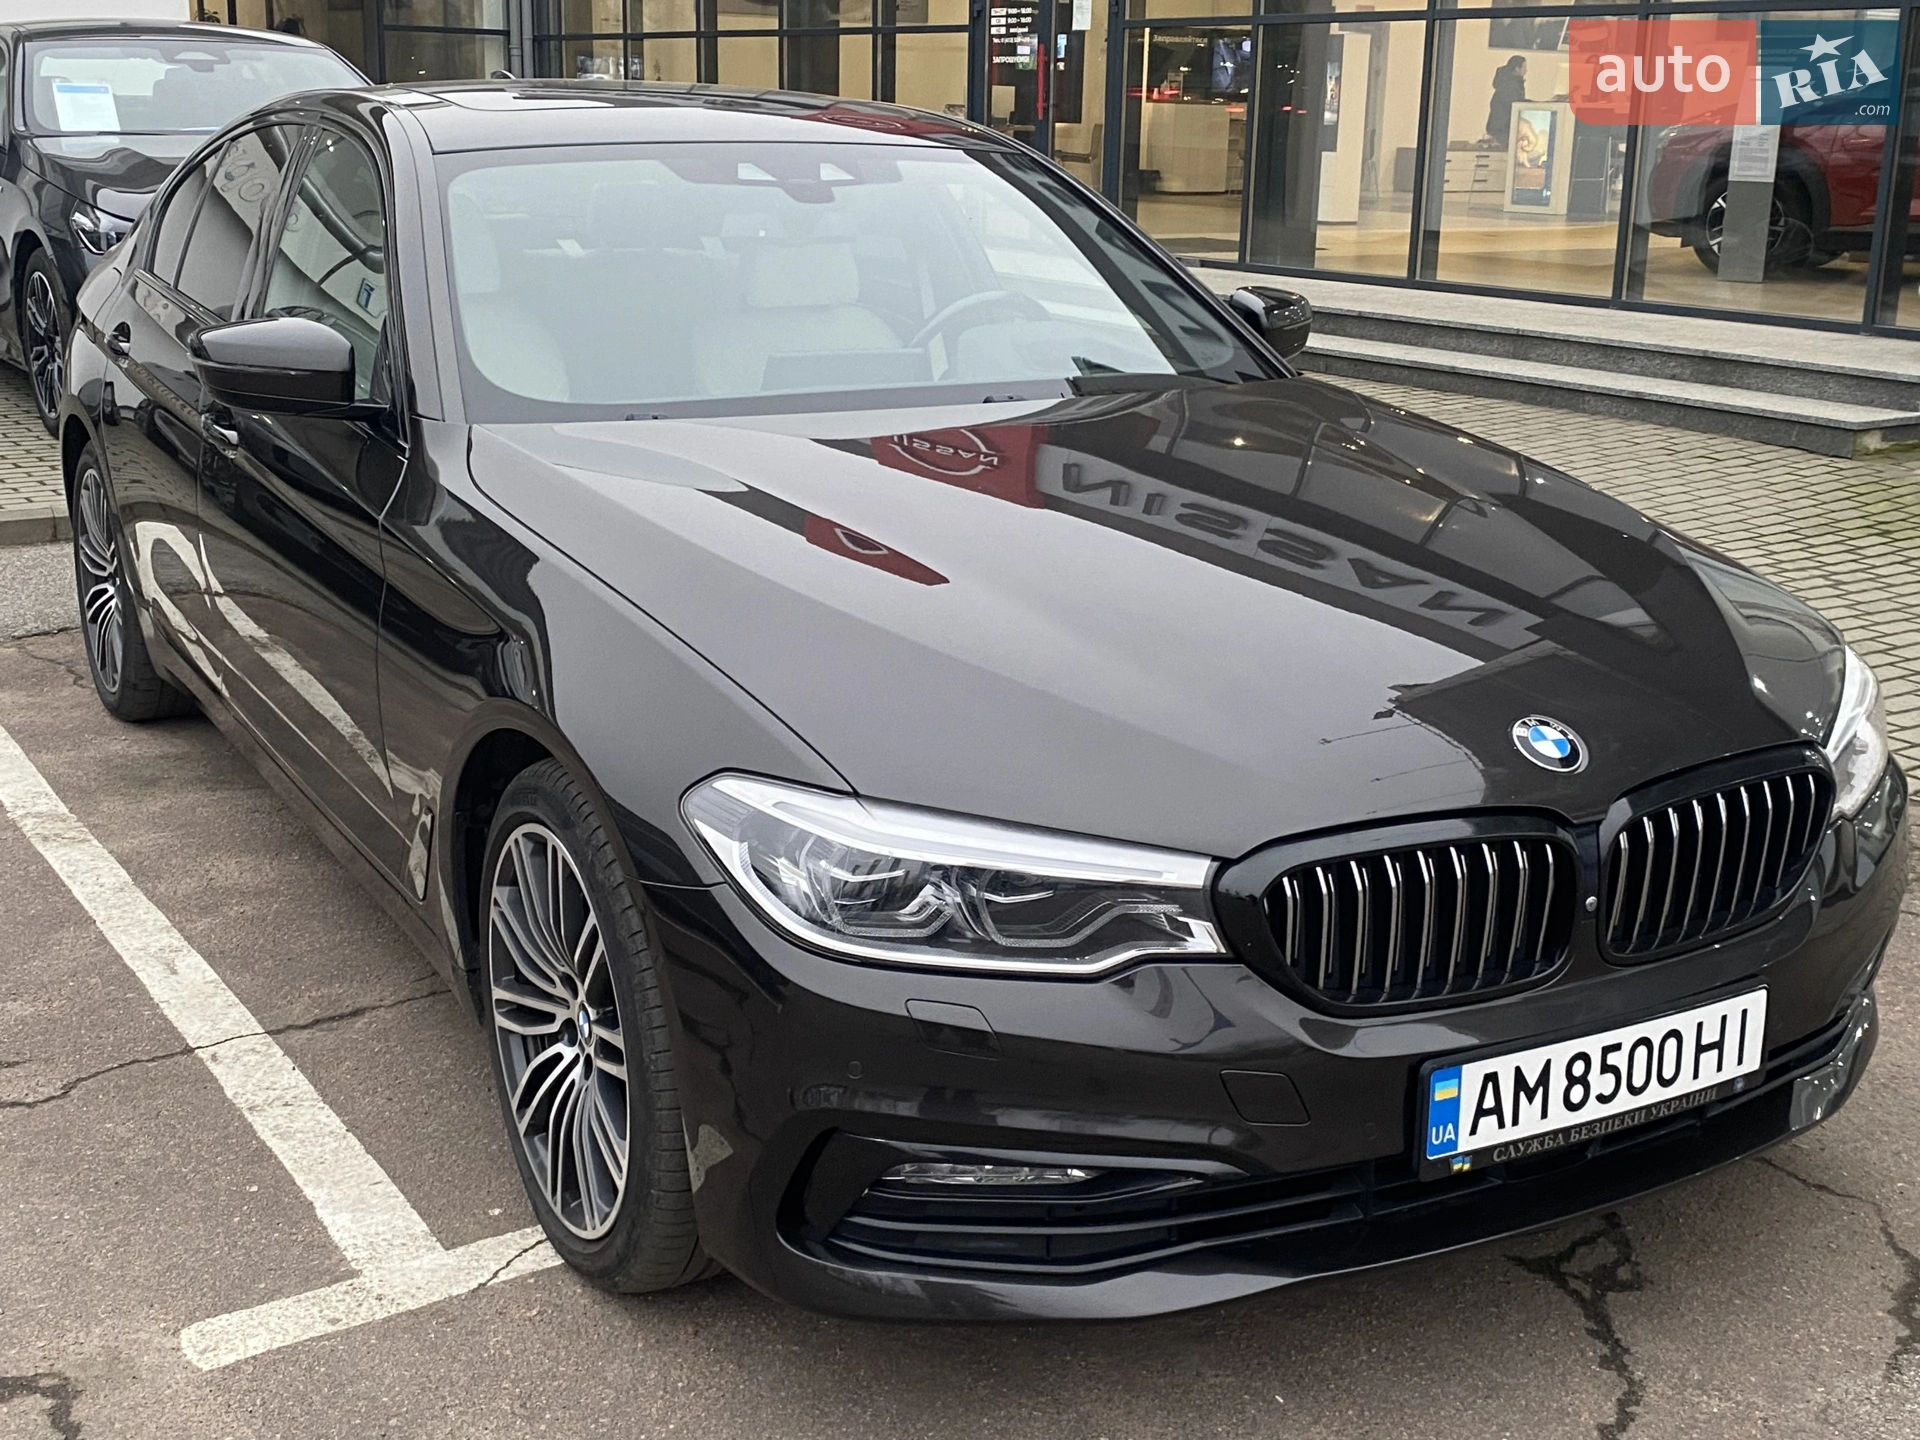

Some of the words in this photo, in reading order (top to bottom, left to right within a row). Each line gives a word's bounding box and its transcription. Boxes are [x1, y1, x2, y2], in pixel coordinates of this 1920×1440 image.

[1431, 1122, 1456, 1145] UA
[1492, 1133, 1565, 1162] СЛУЖБА
[1568, 1110, 1647, 1143] БЕЗПЕКИ
